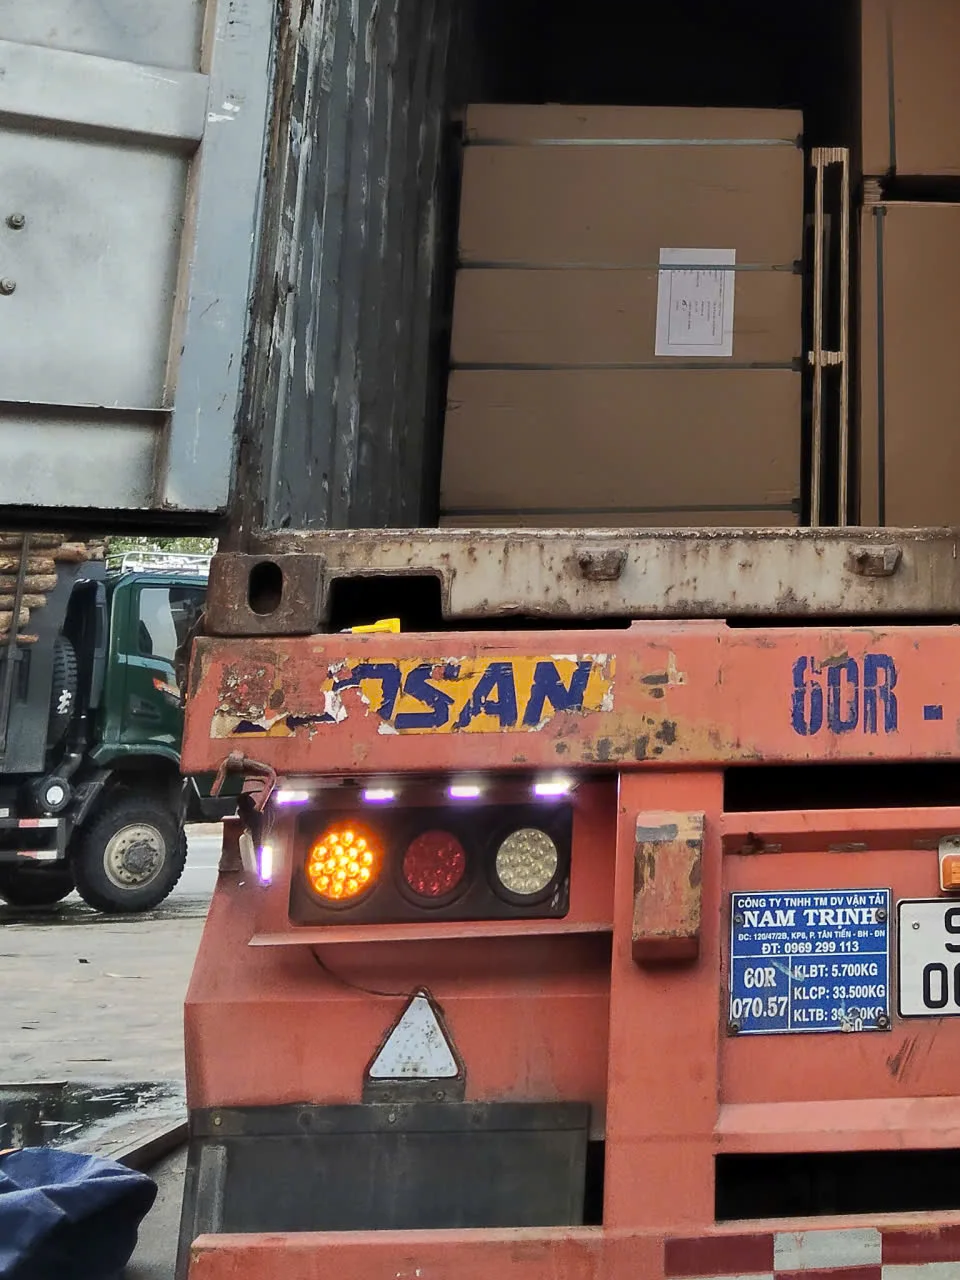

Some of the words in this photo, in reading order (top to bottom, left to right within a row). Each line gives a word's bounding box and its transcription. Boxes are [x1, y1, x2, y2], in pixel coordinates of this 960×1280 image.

[738, 896, 766, 908] CÔNG
[769, 898, 781, 908] TY
[784, 897, 810, 907] TNHH
[814, 896, 827, 906] TM
[830, 896, 843, 906] DV
[846, 894, 866, 907] VẬN
[869, 892, 884, 905] TẢI
[743, 909, 796, 928] NAM
[803, 908, 879, 929] TRỊNH
[858, 930, 868, 938] BH
[761, 943, 780, 954] ĐT:
[784, 943, 812, 953] 0969
[815, 942, 836, 953] 299
[839, 941, 859, 952] 113
[744, 967, 777, 989] 60R
[794, 964, 828, 978] KLBT:
[832, 963, 878, 977] 5.700KG
[794, 986, 829, 1000] KLCP:
[833, 985, 885, 999] 33.500KG
[732, 996, 788, 1019] 070.57
[794, 1009, 828, 1022] KLTB:
